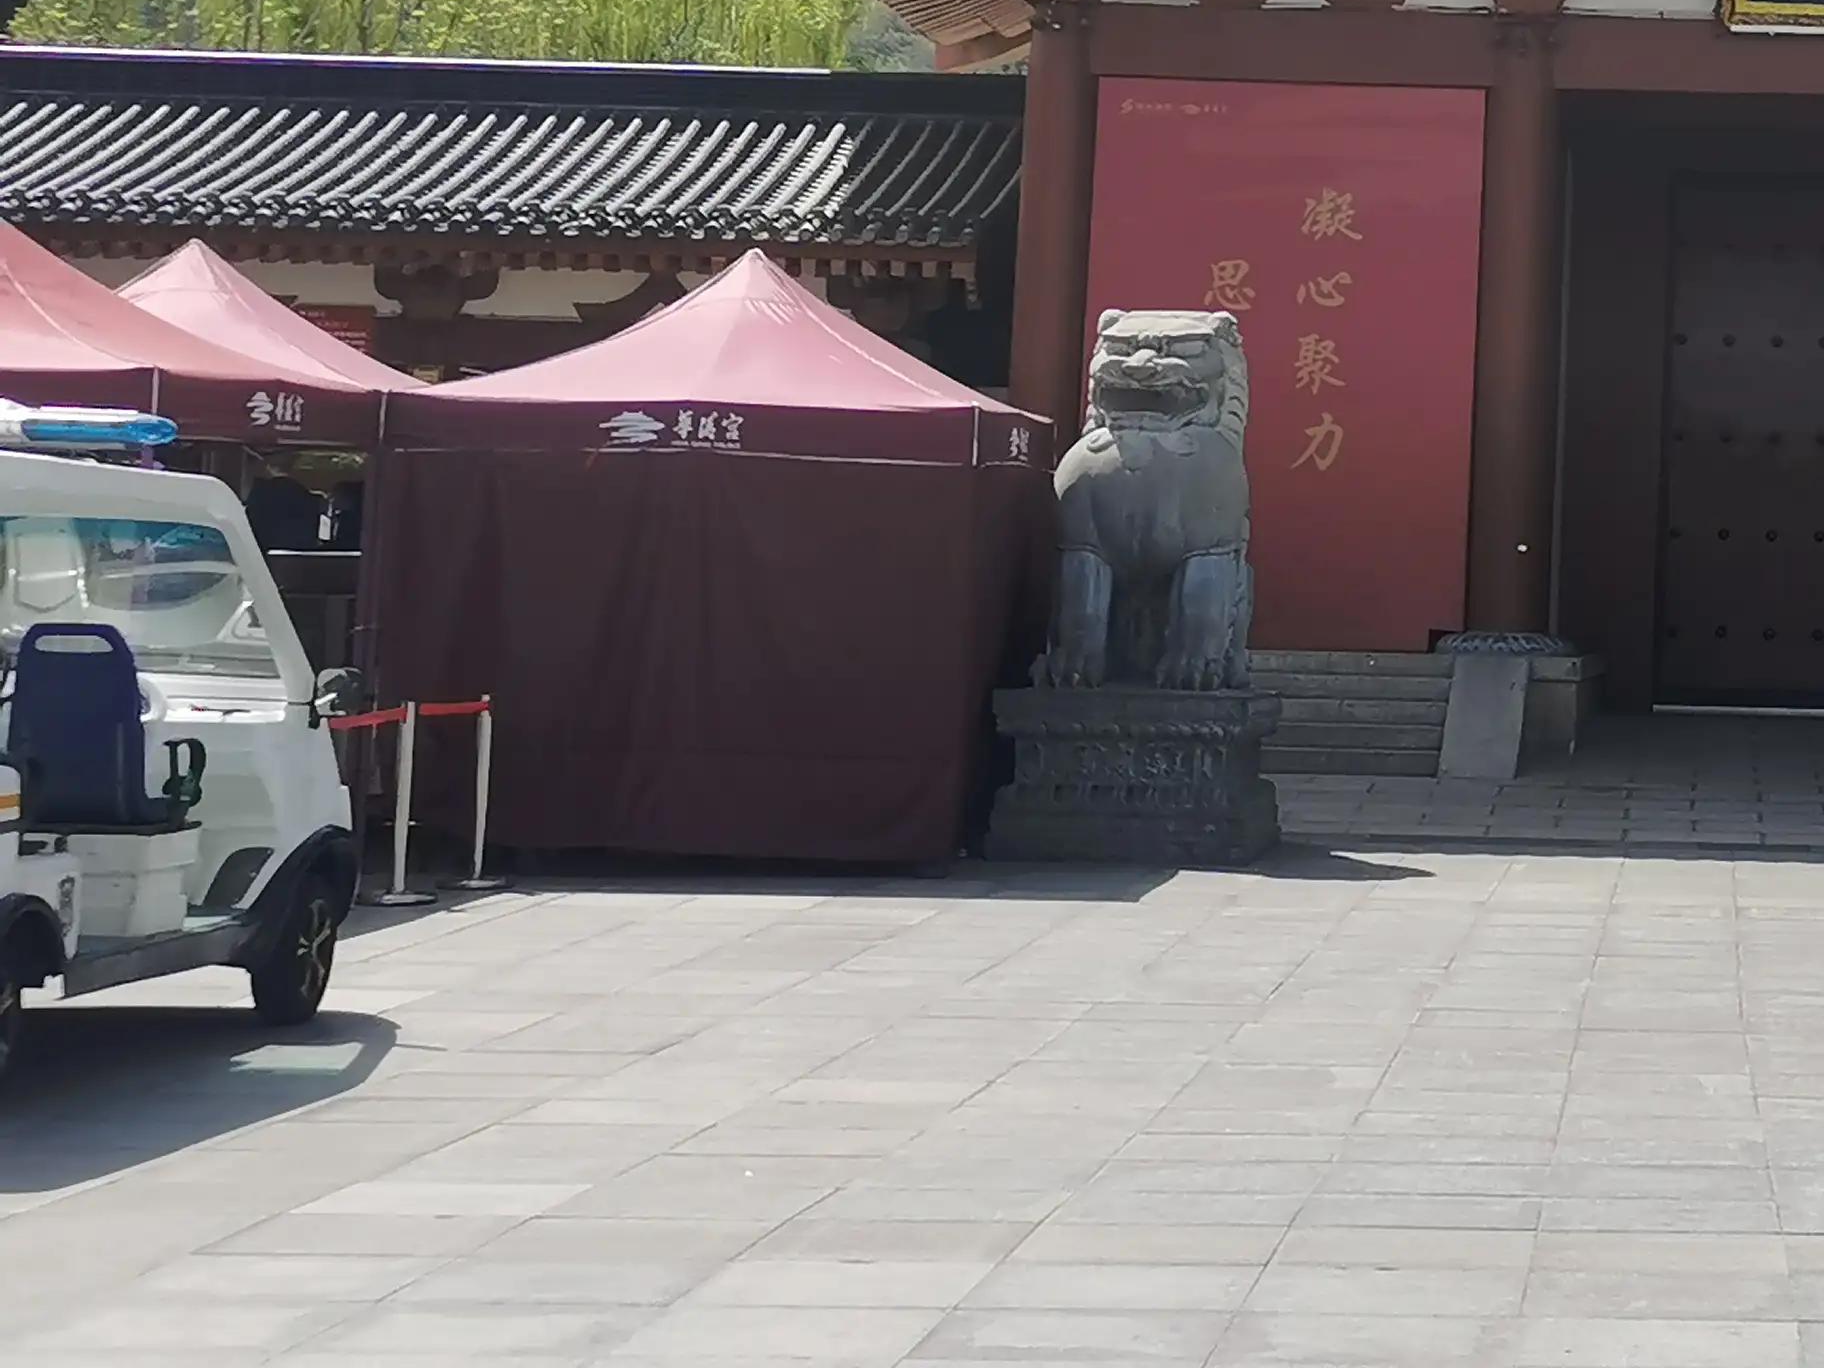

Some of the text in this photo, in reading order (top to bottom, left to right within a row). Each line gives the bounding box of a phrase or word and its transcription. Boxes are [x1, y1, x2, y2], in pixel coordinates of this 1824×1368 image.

[1203, 258, 1256, 311] 思
[1290, 186, 1364, 472] 凝心聚力
